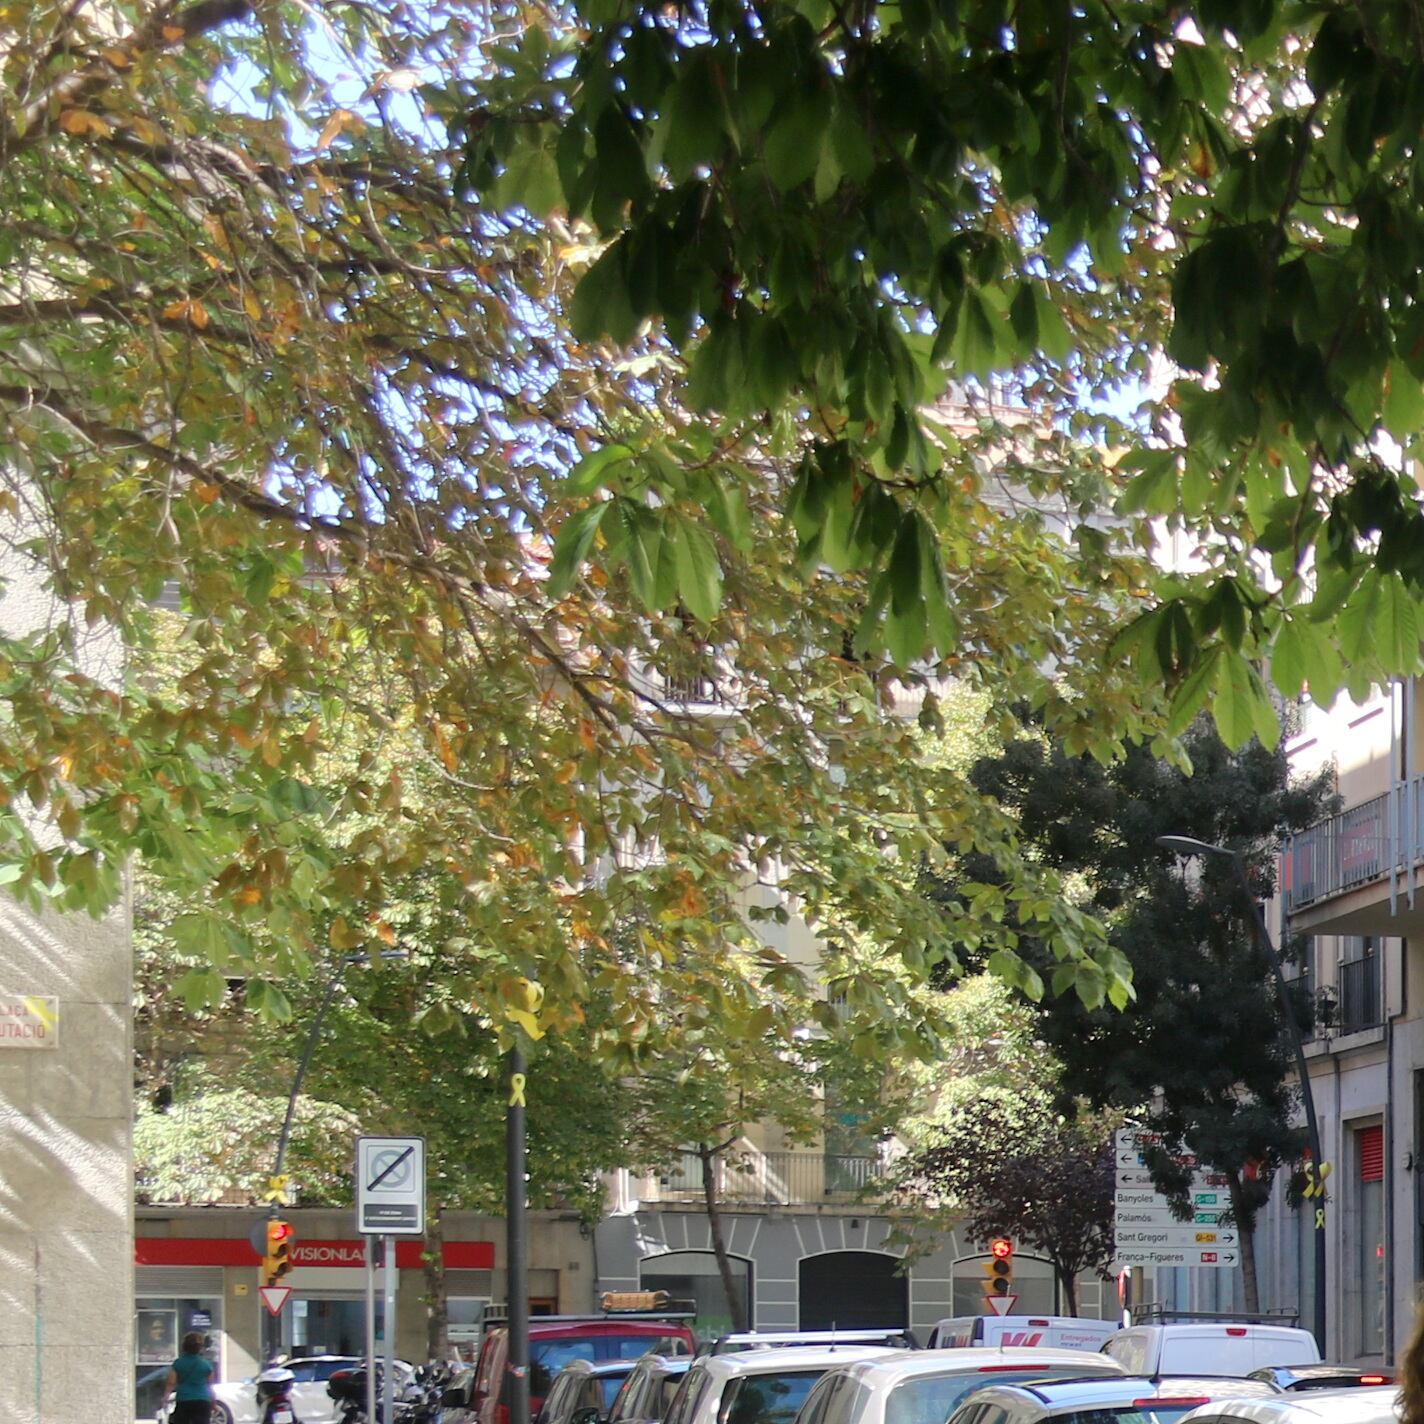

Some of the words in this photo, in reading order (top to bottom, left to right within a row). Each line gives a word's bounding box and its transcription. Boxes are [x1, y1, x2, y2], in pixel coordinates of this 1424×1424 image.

[1117, 1194, 1154, 1204] Banyoles
[1117, 1213, 1152, 1222] Palamós
[1117, 1232, 1136, 1242] Sant
[1137, 1232, 1168, 1244] Gregori
[290, 1247, 366, 1261] VISIONLA
